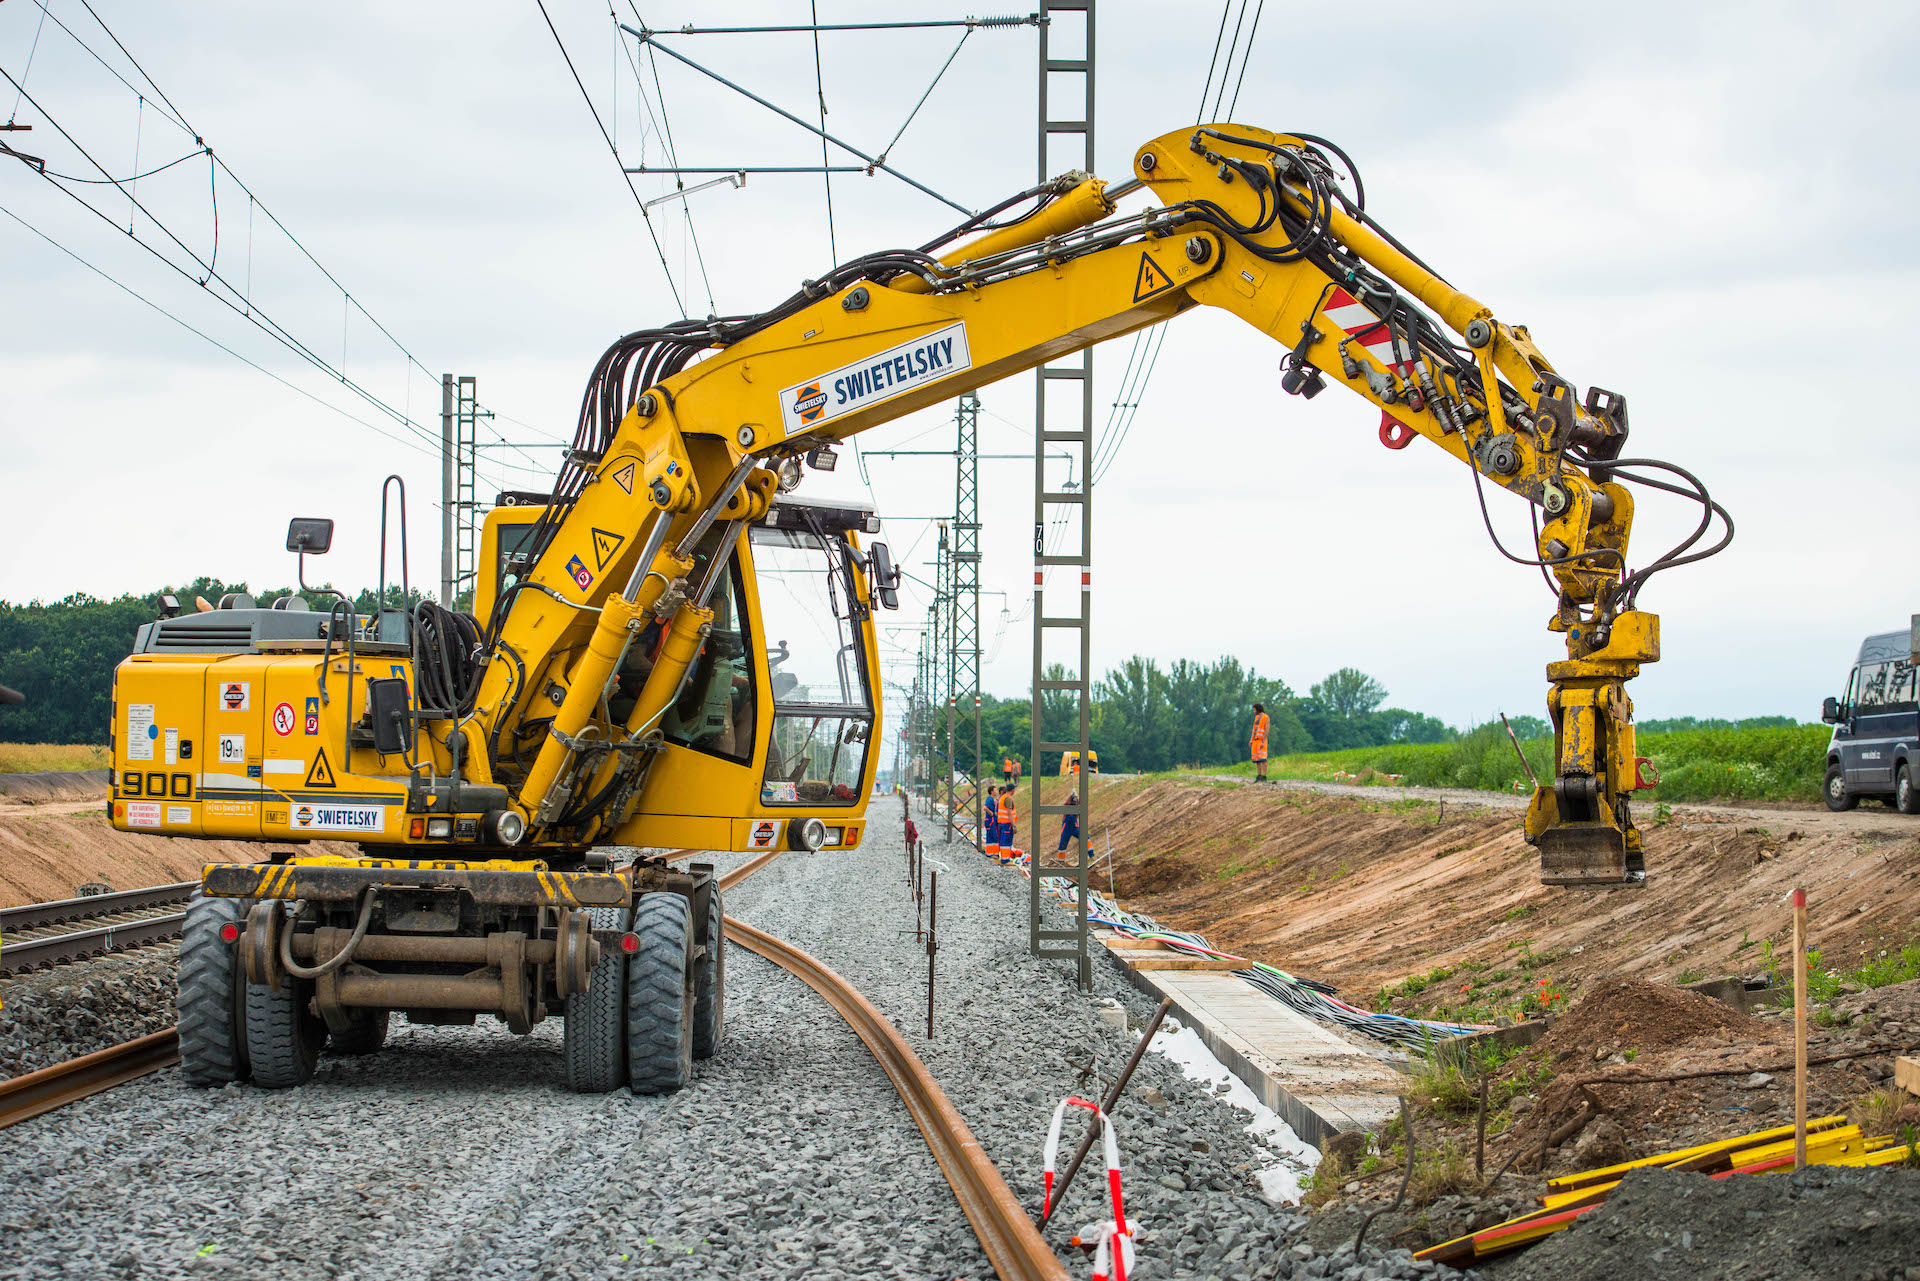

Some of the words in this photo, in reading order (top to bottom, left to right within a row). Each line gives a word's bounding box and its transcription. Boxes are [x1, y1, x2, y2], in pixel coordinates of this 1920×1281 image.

[834, 336, 953, 405] SWIETELSKY
[794, 394, 826, 413] SWIETELSKY
[1035, 524, 1043, 553] 70
[220, 739, 233, 758] 19
[123, 772, 192, 798] 900
[317, 809, 378, 826] SWIETELSKY
